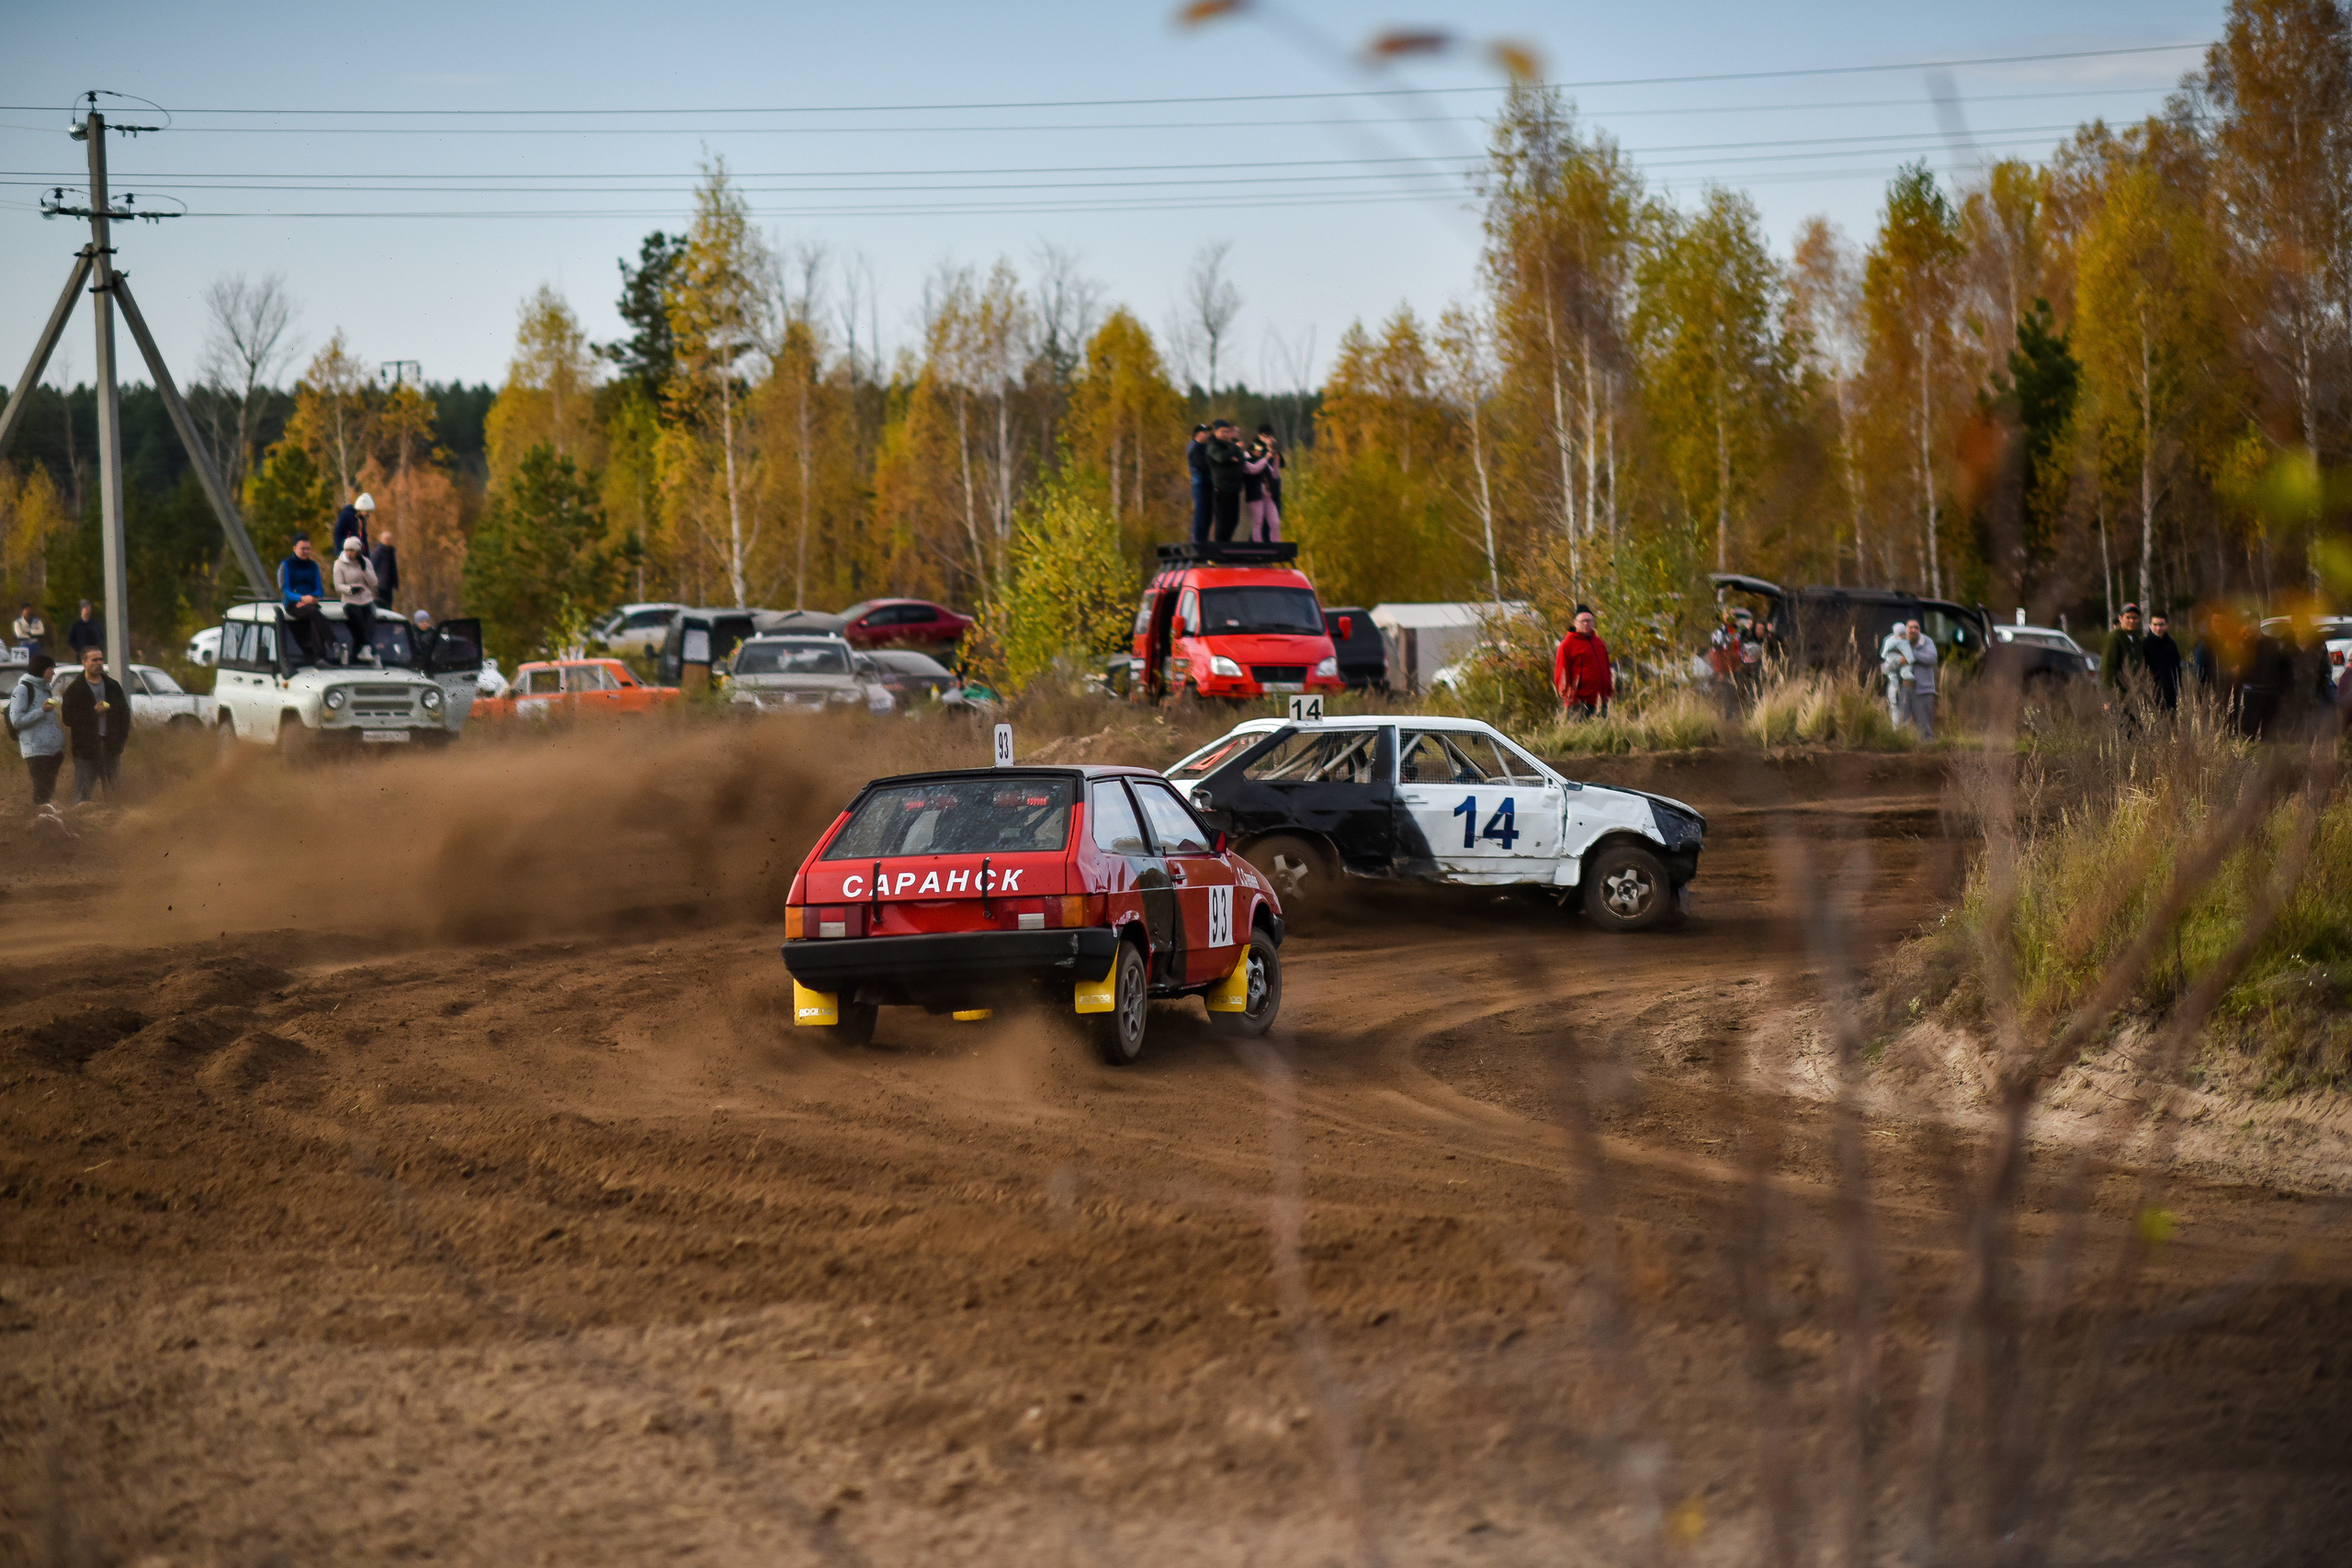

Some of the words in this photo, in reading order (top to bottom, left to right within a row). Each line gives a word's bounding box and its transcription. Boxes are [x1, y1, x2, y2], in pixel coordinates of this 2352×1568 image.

[1292, 699, 1321, 720] 14
[999, 731, 1009, 760] 93
[1453, 795, 1520, 850] 14
[842, 869, 1023, 898] САРАНСК
[1213, 887, 1227, 943] 93
